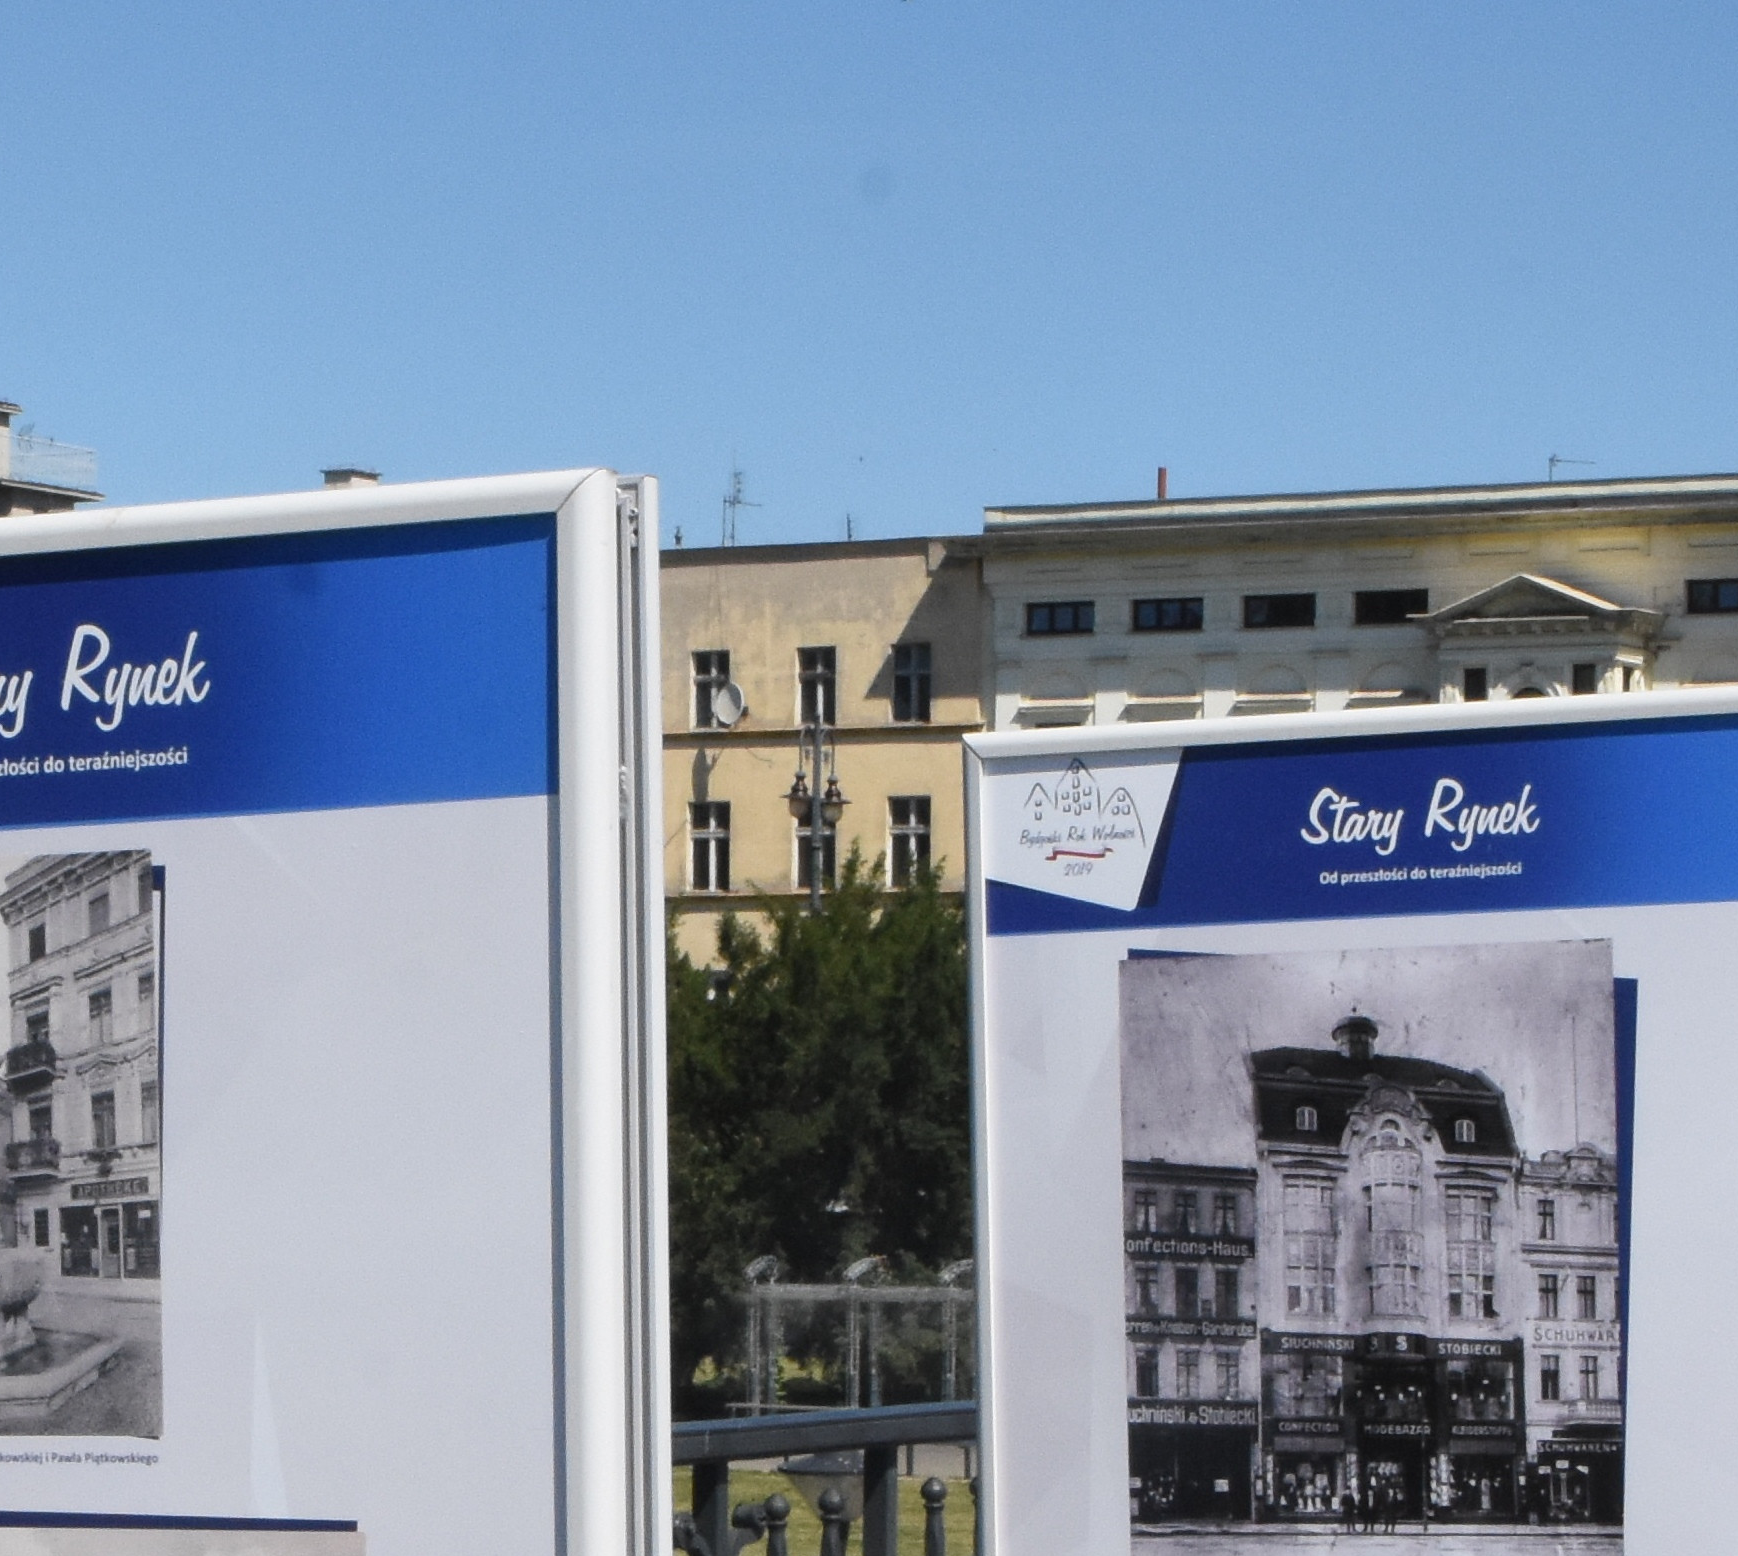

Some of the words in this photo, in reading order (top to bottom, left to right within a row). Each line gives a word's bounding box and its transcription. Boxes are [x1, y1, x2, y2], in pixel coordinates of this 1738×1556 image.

[60, 624, 211, 732] Rynek
[43, 754, 64, 773] do
[68, 745, 188, 772] teraźniejszości
[1300, 787, 1404, 856] Stary
[1424, 778, 1540, 852] Rynek
[1318, 870, 1337, 884] Od
[1340, 867, 1407, 886] przeszłości
[1410, 866, 1426, 880] do
[1429, 861, 1522, 879] teraźniejszości
[1126, 1237, 1254, 1257] onfections-Haus.
[1533, 1327, 1617, 1341] SCHUHWAR
